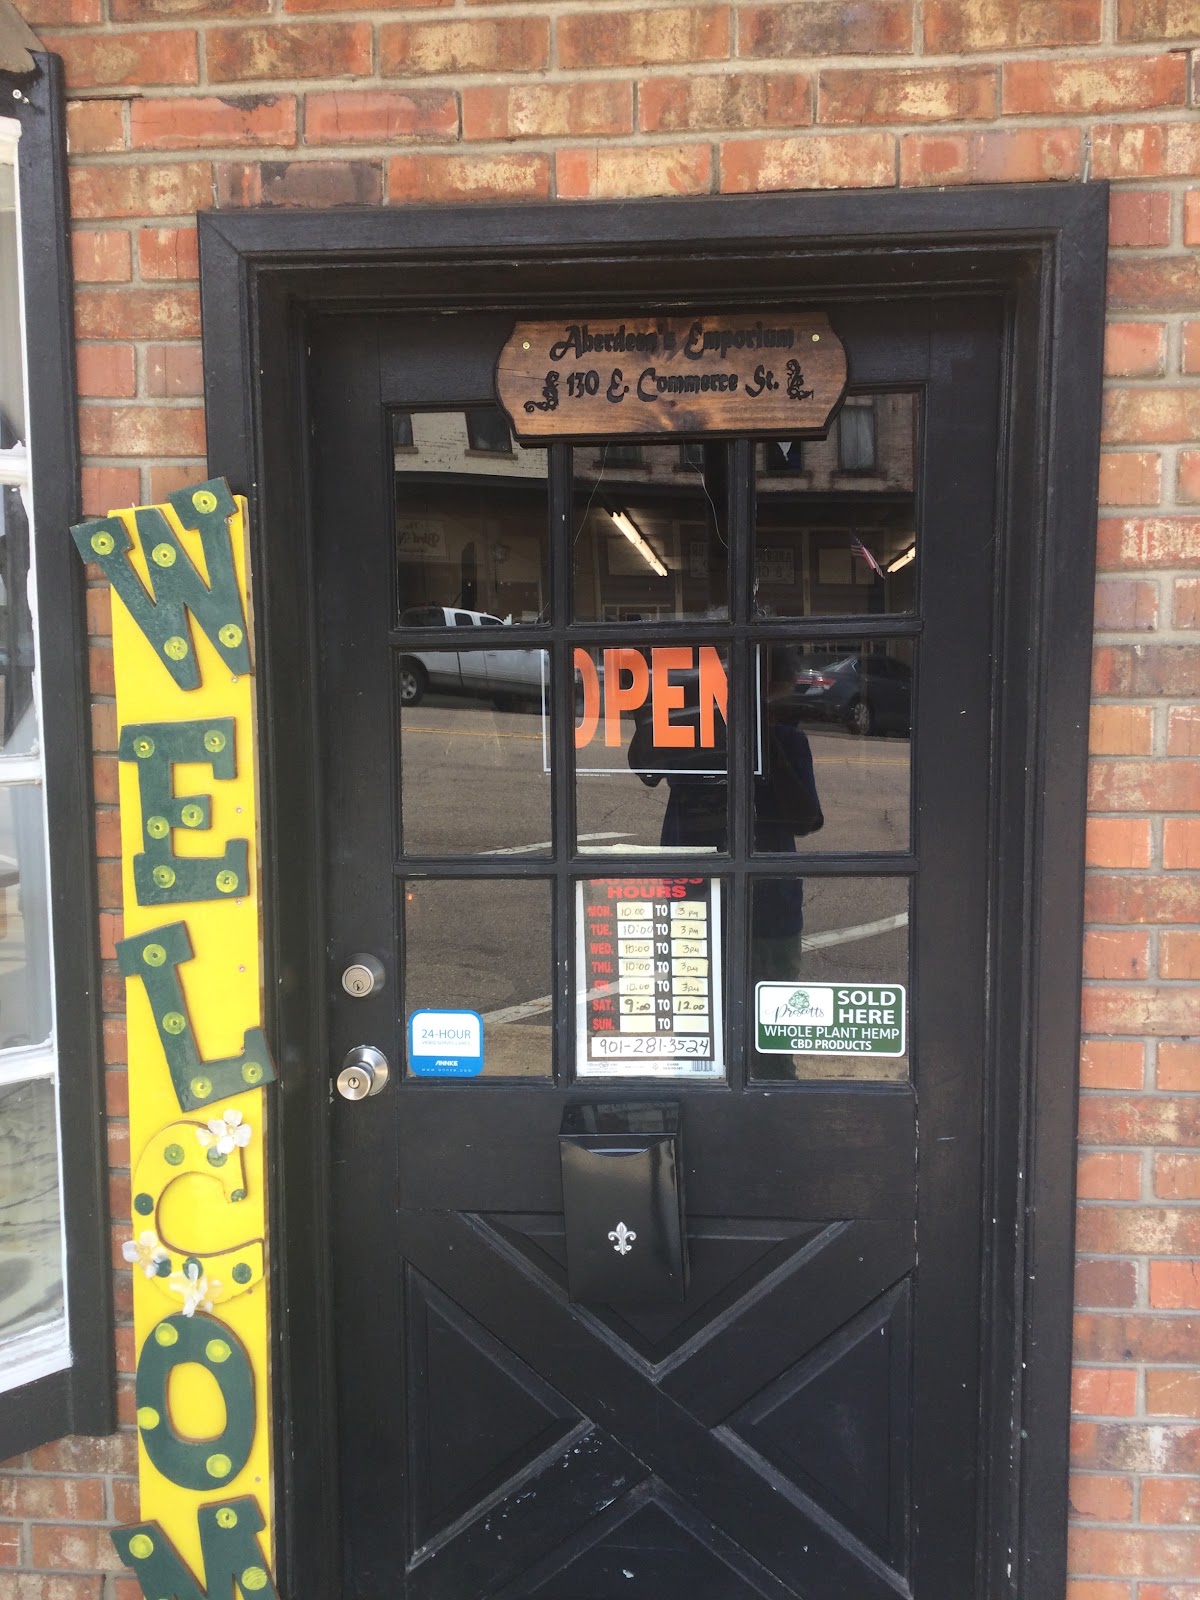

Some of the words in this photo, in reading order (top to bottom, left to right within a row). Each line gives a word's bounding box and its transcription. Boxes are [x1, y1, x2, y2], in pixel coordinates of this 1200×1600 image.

[550, 324, 676, 362] Aberdeen's
[684, 321, 796, 360] Emporium
[566, 370, 600, 398] 130
[637, 367, 739, 403] Commerce
[745, 364, 780, 398] St.
[607, 885, 687, 899] HOURS
[655, 904, 669, 917] TO
[590, 923, 613, 936] TUE.
[656, 923, 669, 937] TO
[590, 942, 614, 955] WED.
[656, 942, 669, 955] TO
[591, 961, 614, 974] THU.
[657, 961, 670, 974] TO
[657, 980, 670, 993] TO
[658, 998, 671, 1011] TO
[837, 990, 897, 1006] SOLD
[838, 1008, 895, 1025] HERE
[592, 1017, 616, 1030] SUN.
[658, 1017, 671, 1030] TO
[421, 1028, 471, 1040] 24-HOUR
[764, 1025, 813, 1037] WHOLE
[816, 1026, 858, 1039] PLANT
[861, 1027, 900, 1040] HEMP
[599, 1036, 710, 1055] 901-281-3524
[790, 1039, 813, 1049] CBD
[815, 1039, 872, 1051] PRODUCTS
